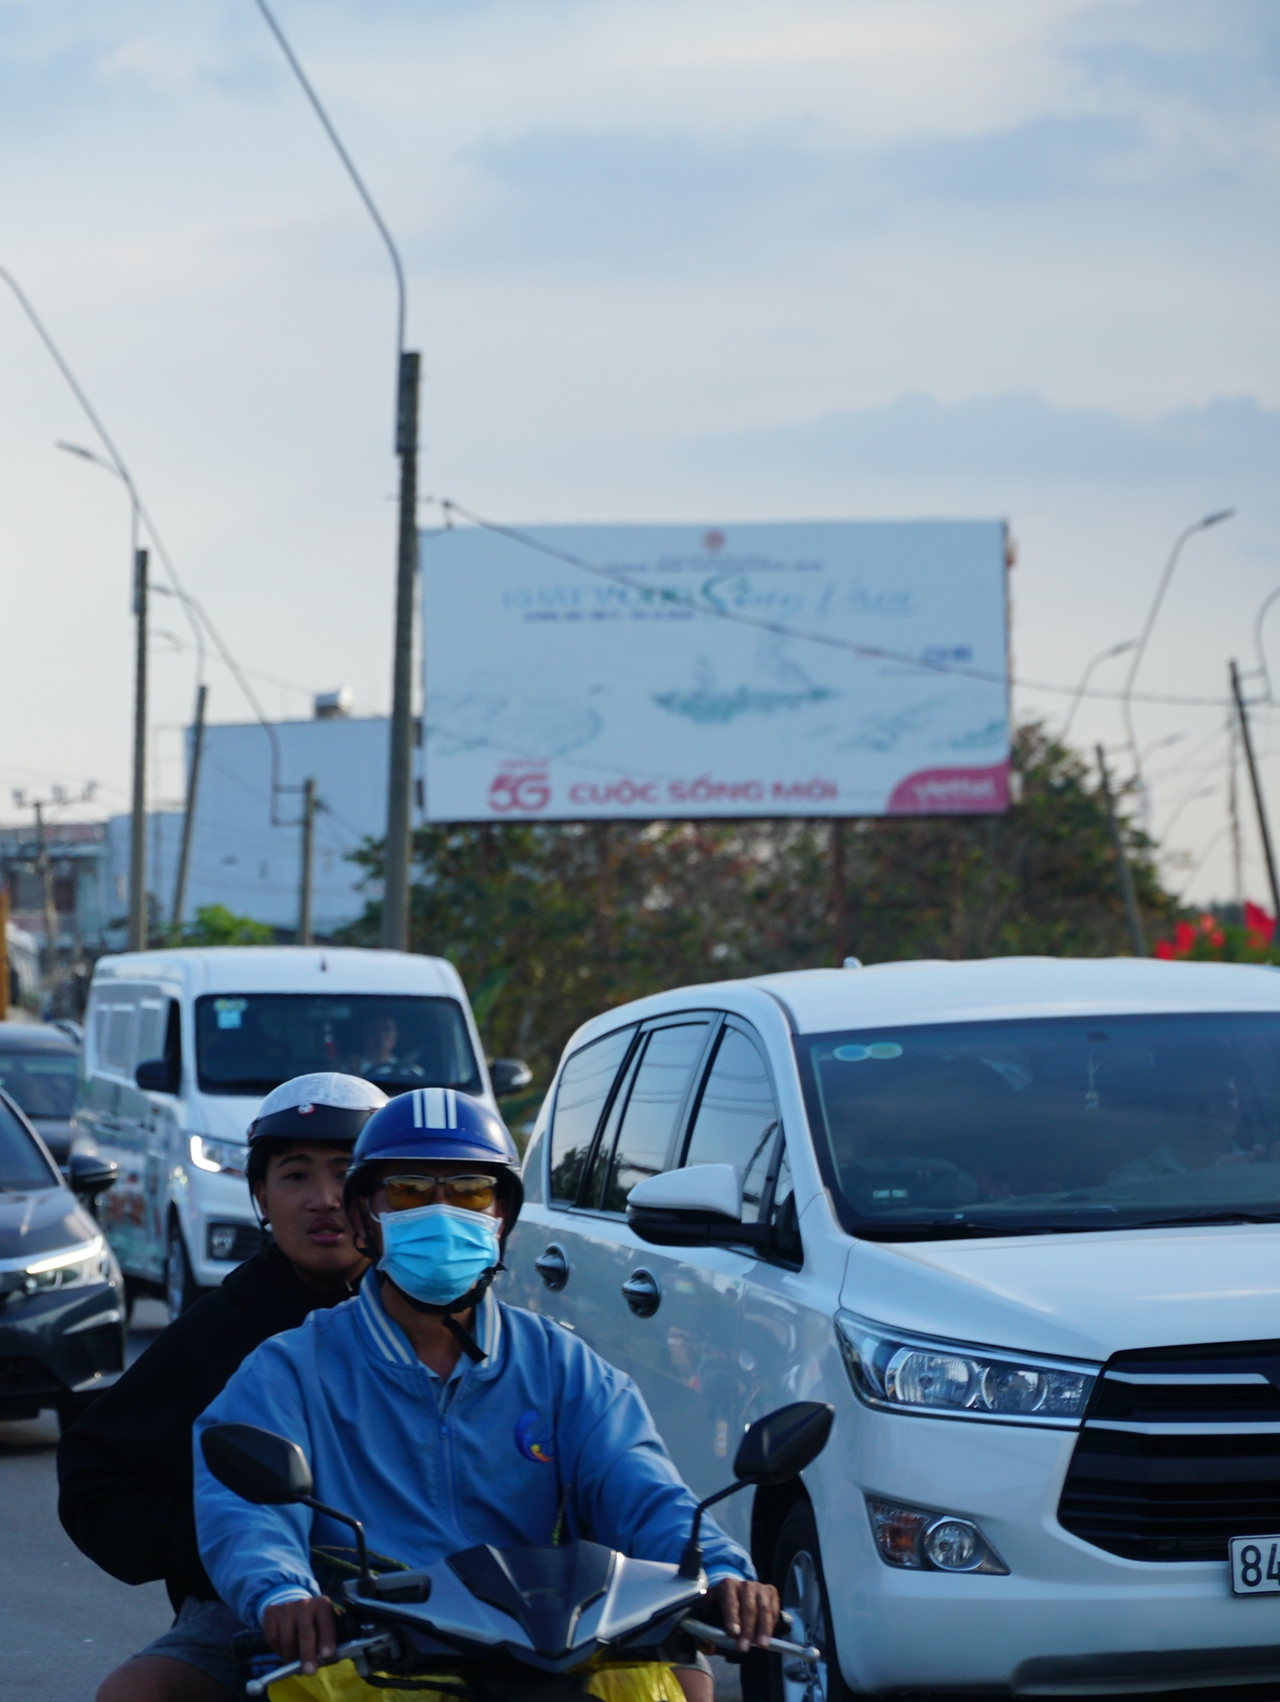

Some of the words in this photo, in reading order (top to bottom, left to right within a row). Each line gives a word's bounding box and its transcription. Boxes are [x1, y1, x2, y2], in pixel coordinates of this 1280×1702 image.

[488, 774, 551, 814] 5G
[569, 777, 660, 807] CUỘC
[1240, 1543, 1280, 1588] 84
